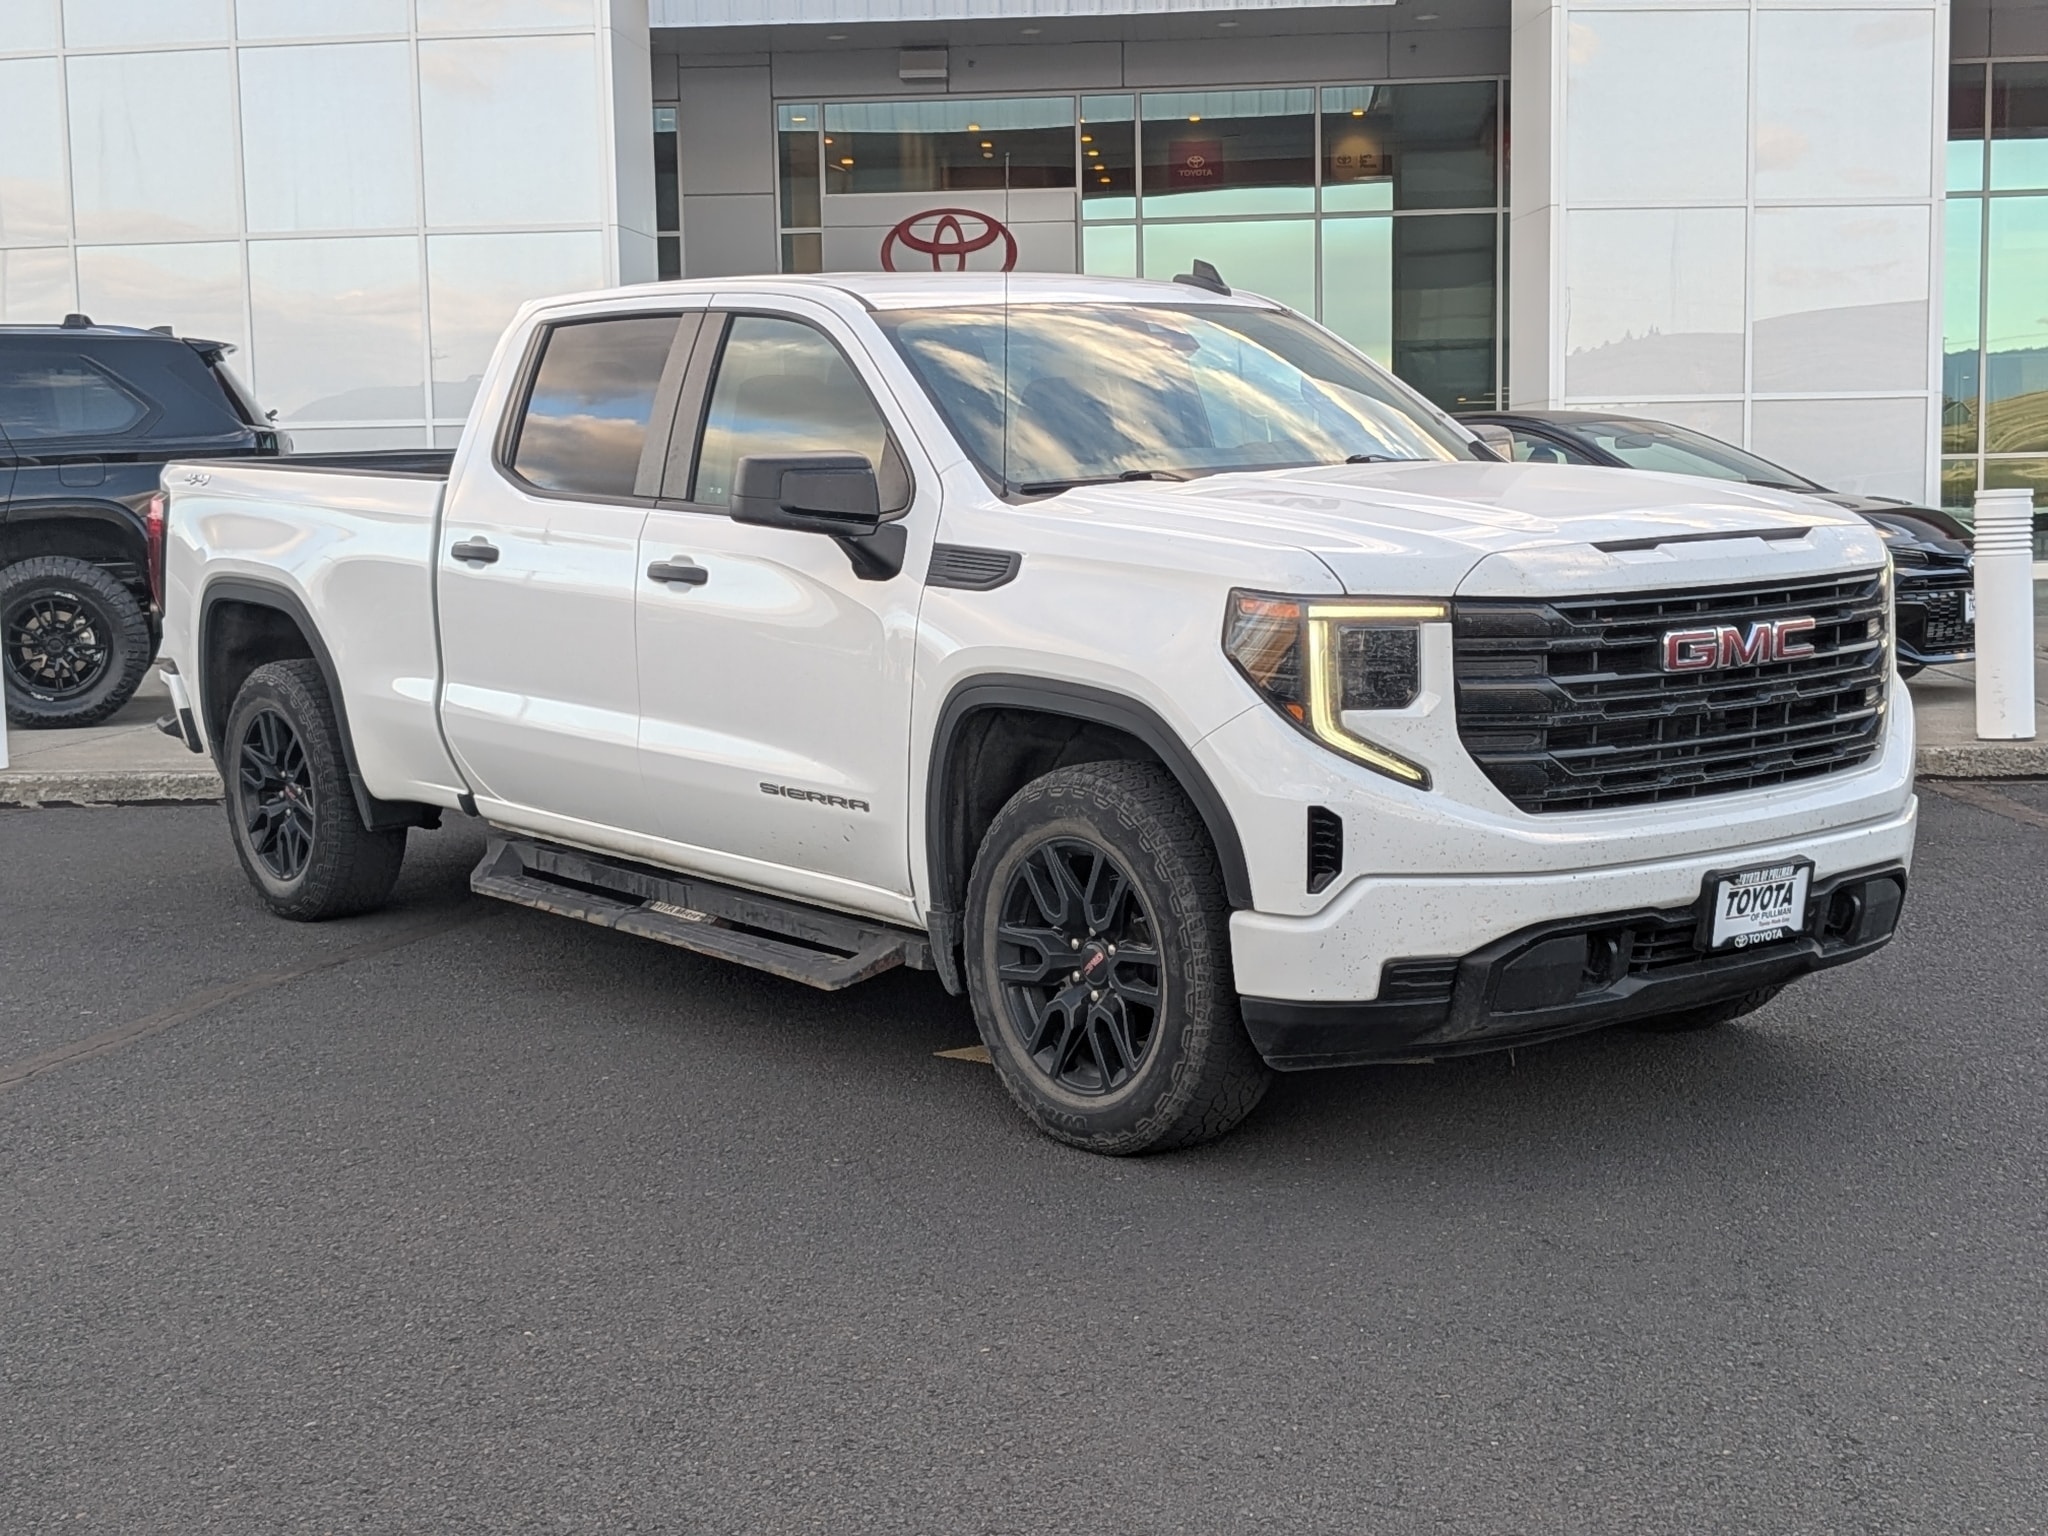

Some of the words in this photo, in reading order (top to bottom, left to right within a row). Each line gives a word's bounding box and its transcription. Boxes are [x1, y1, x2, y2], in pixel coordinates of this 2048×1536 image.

[1179, 169, 1213, 177] TOYOTA
[1662, 616, 1816, 672] GMC
[759, 781, 870, 813] SIERRA
[1725, 881, 1794, 917] TOYOTA
[1750, 912, 1760, 922] OF
[1761, 907, 1792, 920] PULLMAN
[1749, 928, 1783, 944] TOYOTA
